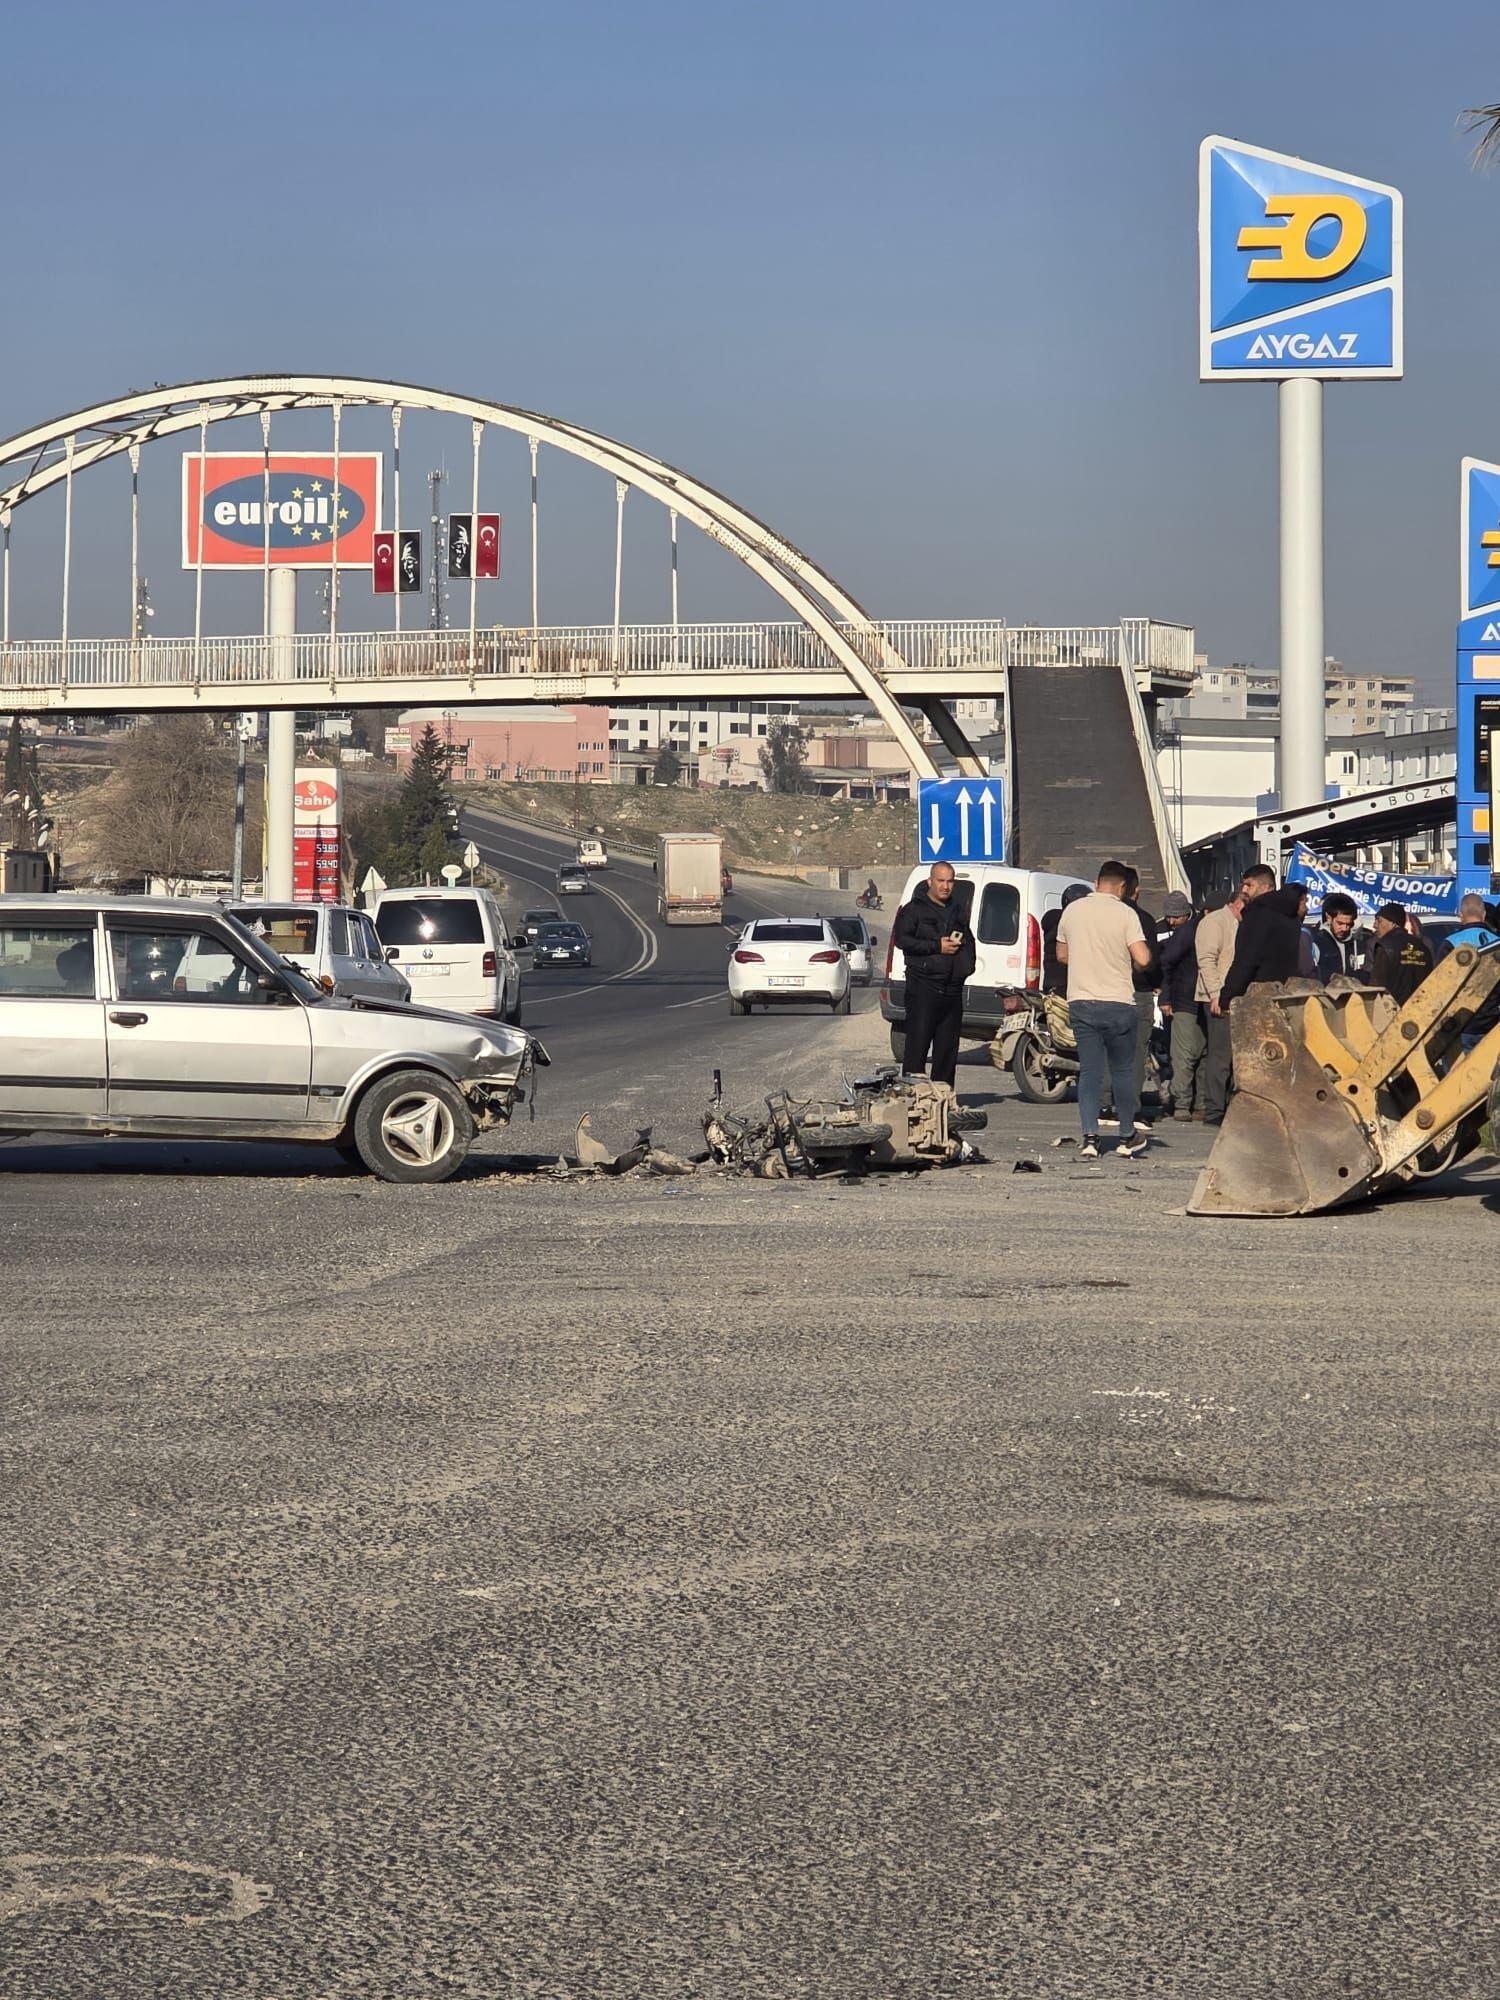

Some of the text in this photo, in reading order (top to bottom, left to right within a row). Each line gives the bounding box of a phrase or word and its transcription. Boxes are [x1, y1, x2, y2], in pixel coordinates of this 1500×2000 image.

[1246, 333, 1359, 359] AYGAZ
[213, 498, 328, 524] euroil
[1481, 622, 1500, 641] A
[1305, 876, 1324, 893] Tek
[1381, 874, 1453, 898] yapar!
